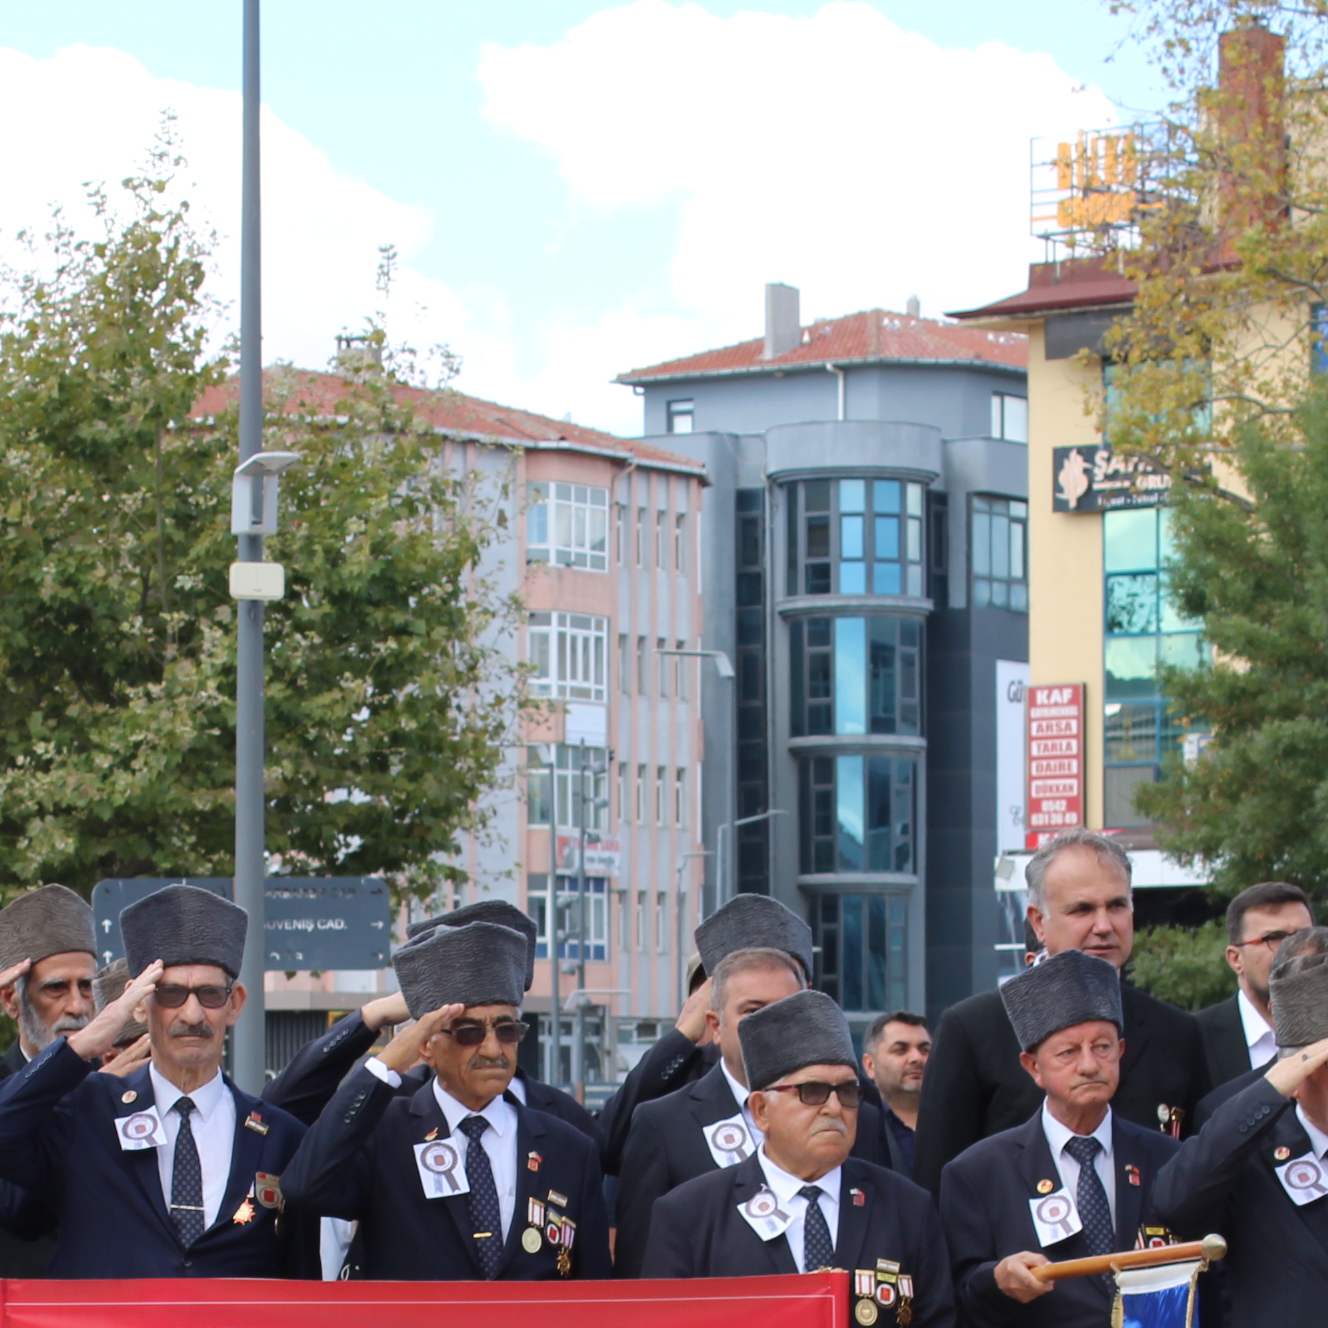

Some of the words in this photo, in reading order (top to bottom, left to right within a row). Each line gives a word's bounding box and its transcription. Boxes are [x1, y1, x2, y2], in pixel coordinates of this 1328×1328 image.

[1035, 688, 1074, 705] KAF
[1036, 720, 1073, 734] ARSA
[1036, 740, 1073, 754] TARLA
[316, 917, 348, 930] CAD.
